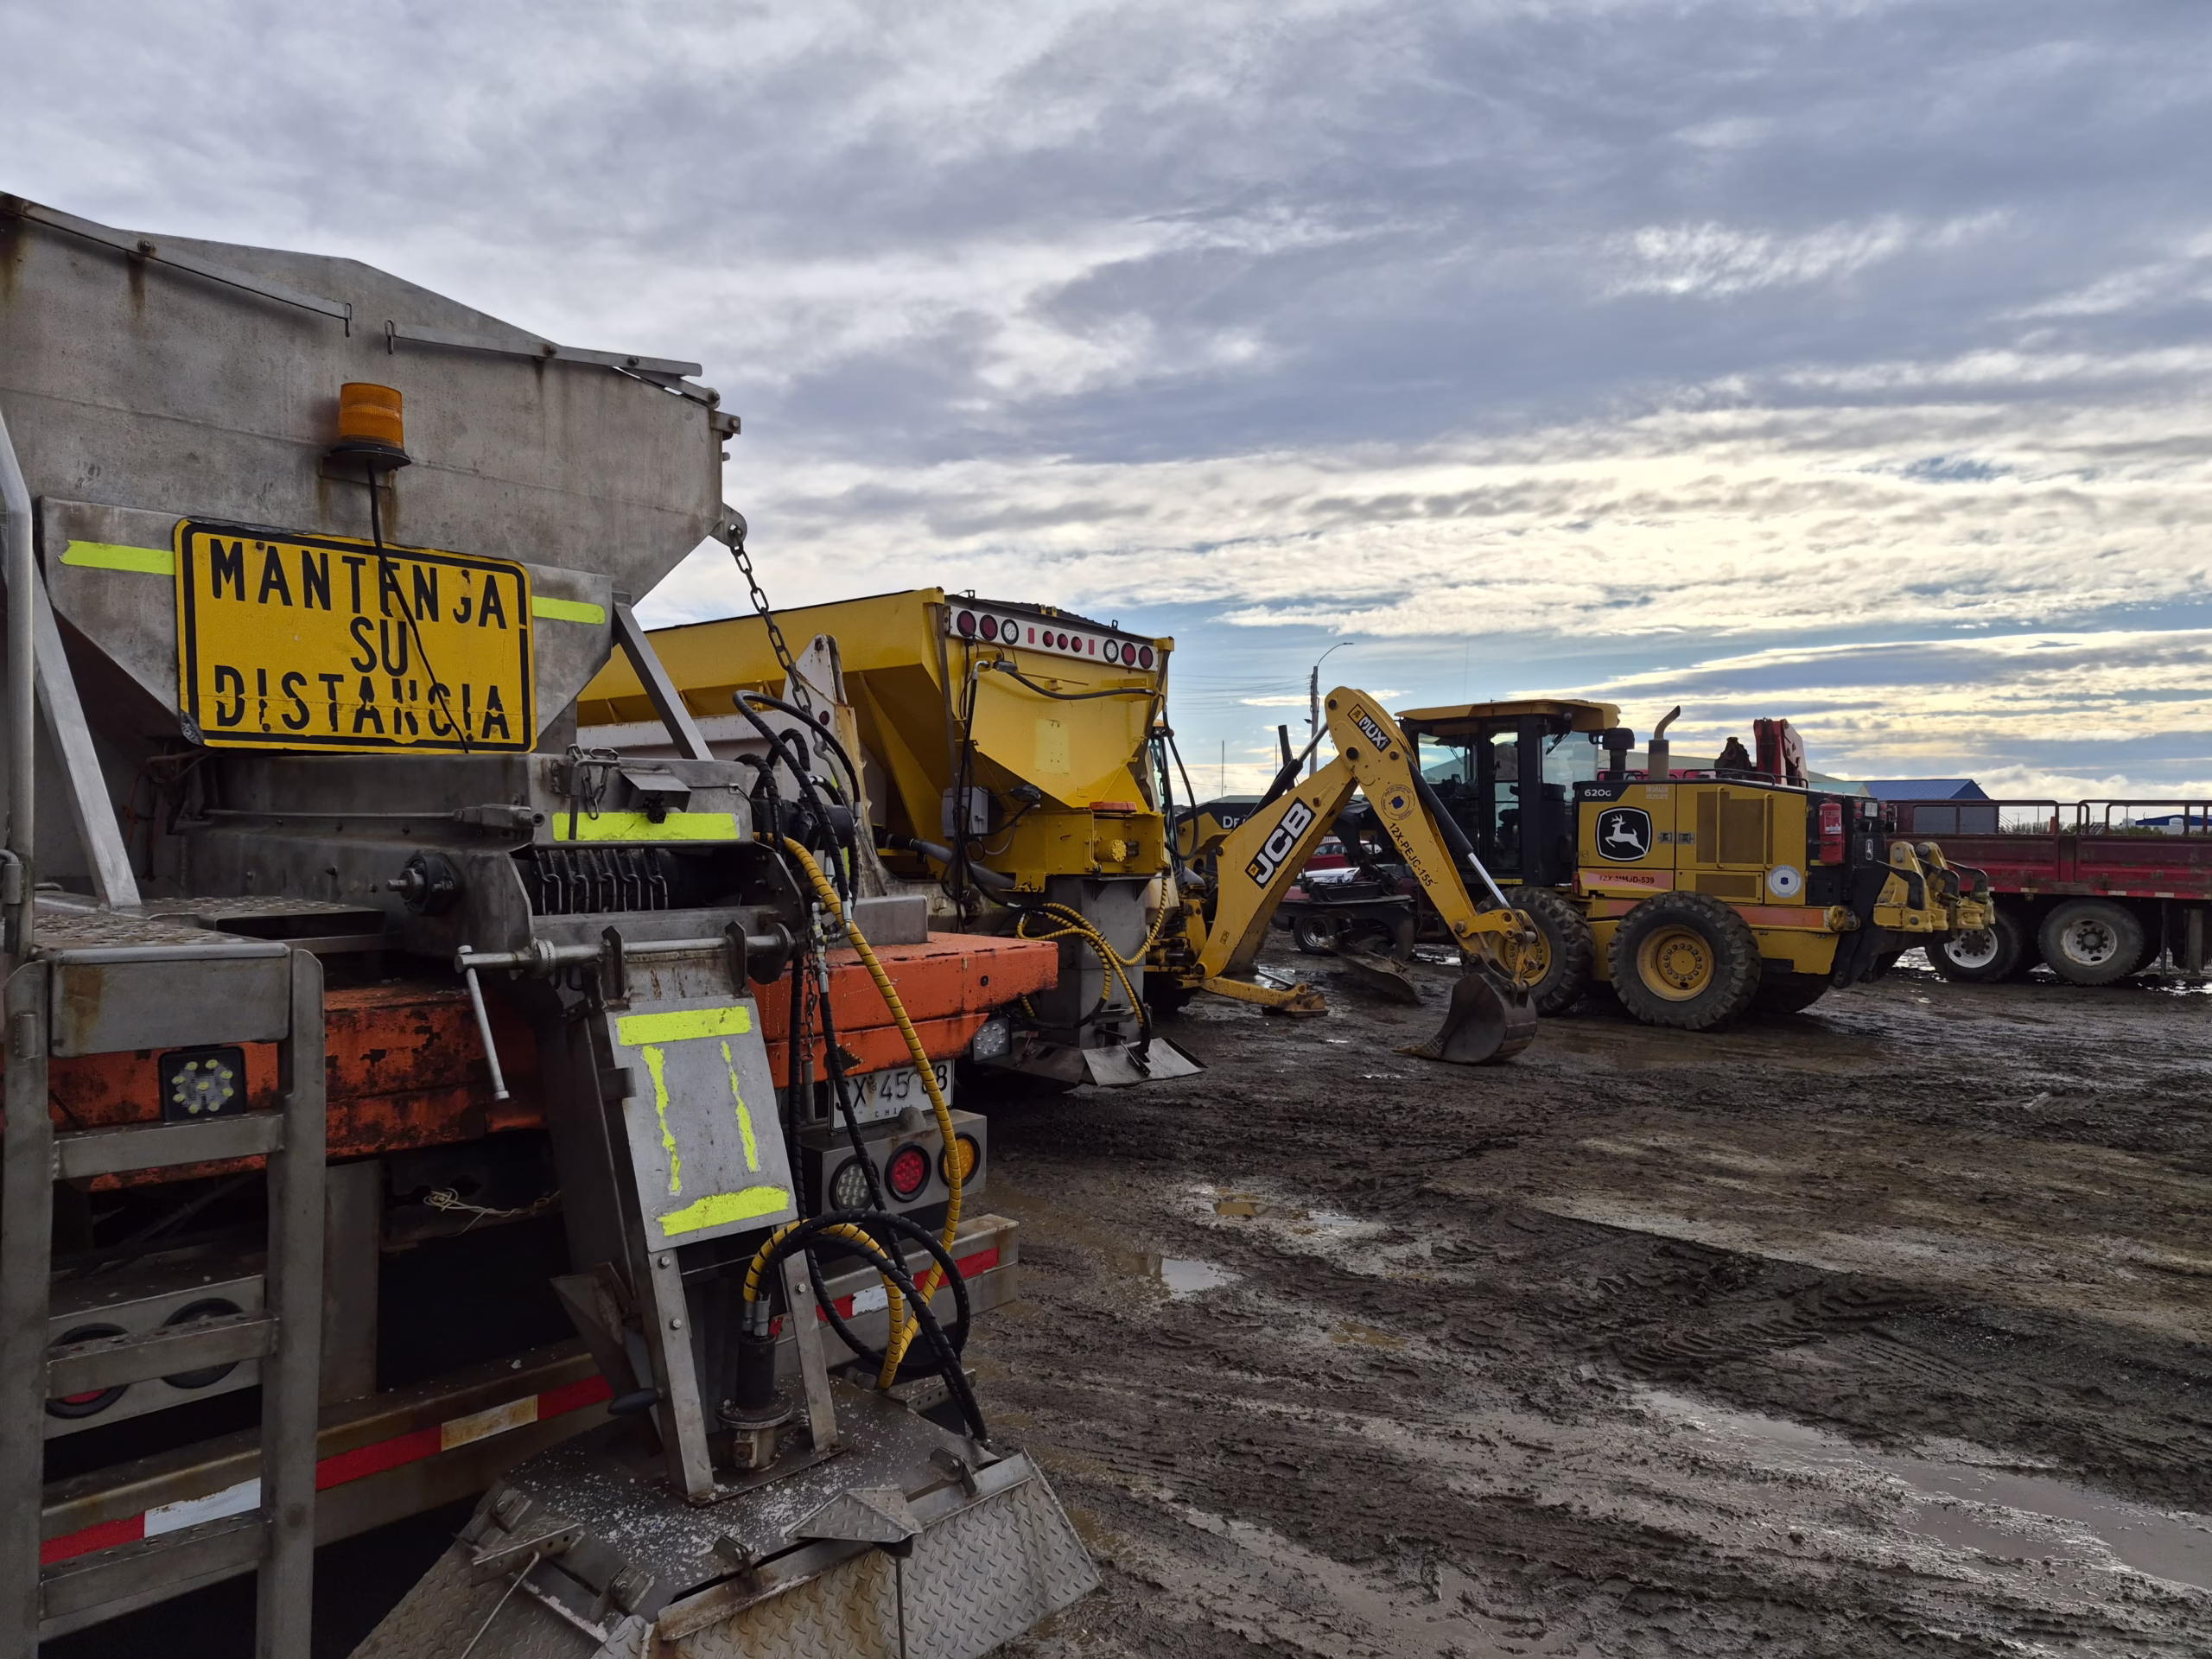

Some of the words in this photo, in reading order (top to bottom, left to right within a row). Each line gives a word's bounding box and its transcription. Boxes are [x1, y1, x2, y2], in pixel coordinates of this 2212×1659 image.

[350, 617, 407, 677] SU
[214, 664, 511, 740] DISTANCIA
[1255, 803, 1312, 884] JCB
[1389, 823, 1433, 887] 12X-PEJC-155
[874, 1103, 913, 1118] CHI
